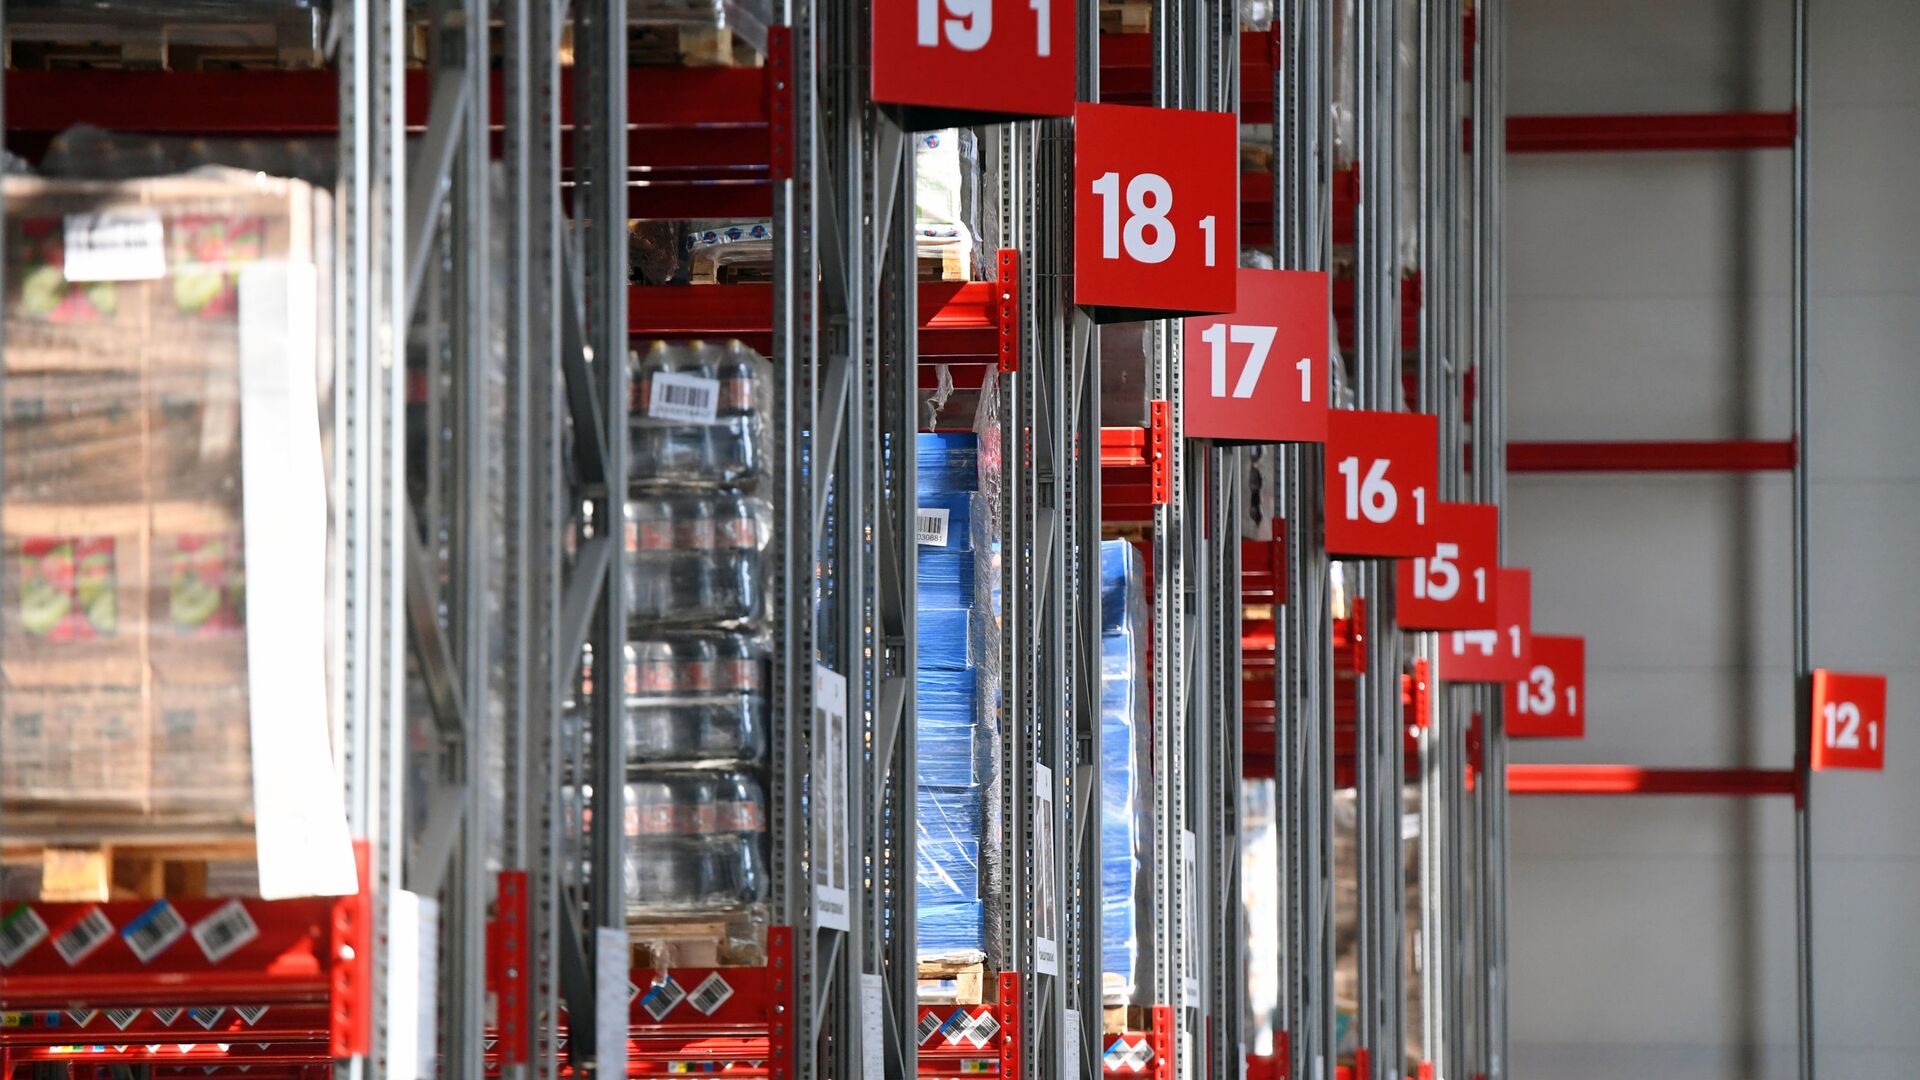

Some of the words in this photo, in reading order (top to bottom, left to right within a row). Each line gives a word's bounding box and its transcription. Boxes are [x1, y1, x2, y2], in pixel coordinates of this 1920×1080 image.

[1030, 0, 1050, 57] 1
[1092, 172, 1176, 263] 18
[1199, 215, 1215, 267] 1
[1202, 323, 1278, 398] 17
[1296, 358, 1311, 402] 1
[1338, 456, 1398, 523] 16
[1412, 486, 1425, 525] 1
[1413, 543, 1460, 601] 15
[1473, 567, 1486, 603] 1
[1508, 624, 1520, 658] 1
[1517, 664, 1556, 716] 13
[1565, 686, 1577, 717] 1
[1823, 701, 1860, 749] 12
[1867, 720, 1878, 751] 1
